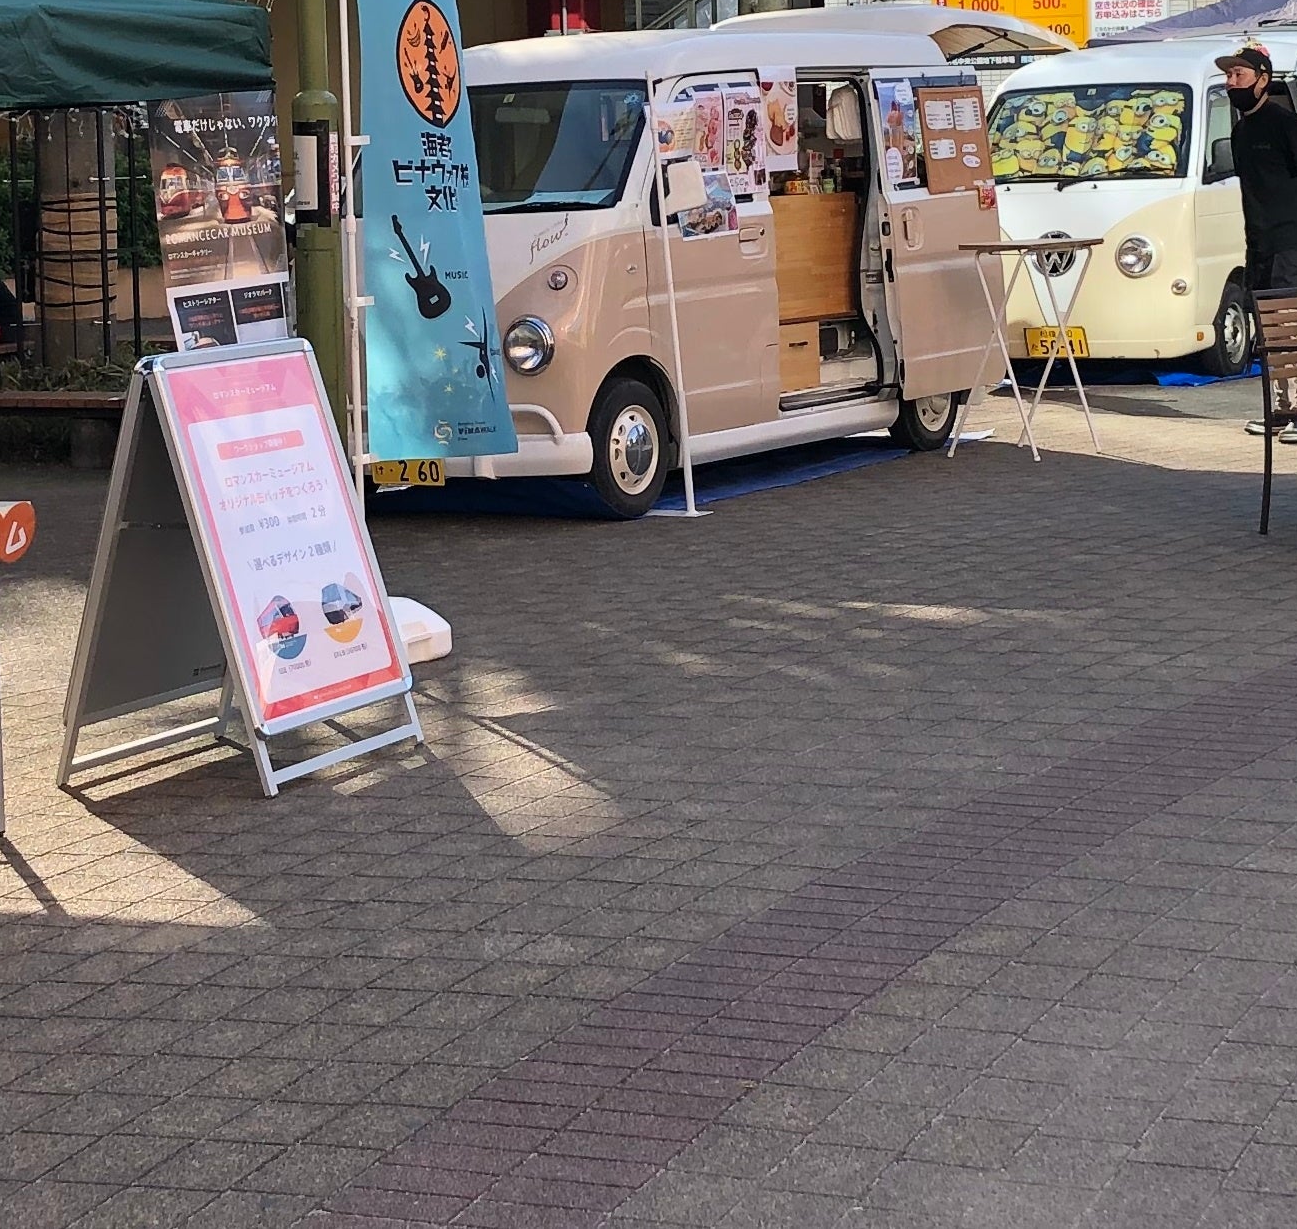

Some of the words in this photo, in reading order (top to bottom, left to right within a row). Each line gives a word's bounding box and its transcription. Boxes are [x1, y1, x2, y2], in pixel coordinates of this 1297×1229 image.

[1094, 0, 1164, 11] 空き状況の確認と
[1094, 9, 1163, 20] お申込みはこちら
[165, 227, 230, 245] ROMANCECAR
[230, 222, 272, 238] MUSEUM
[445, 270, 469, 280] MUSIC
